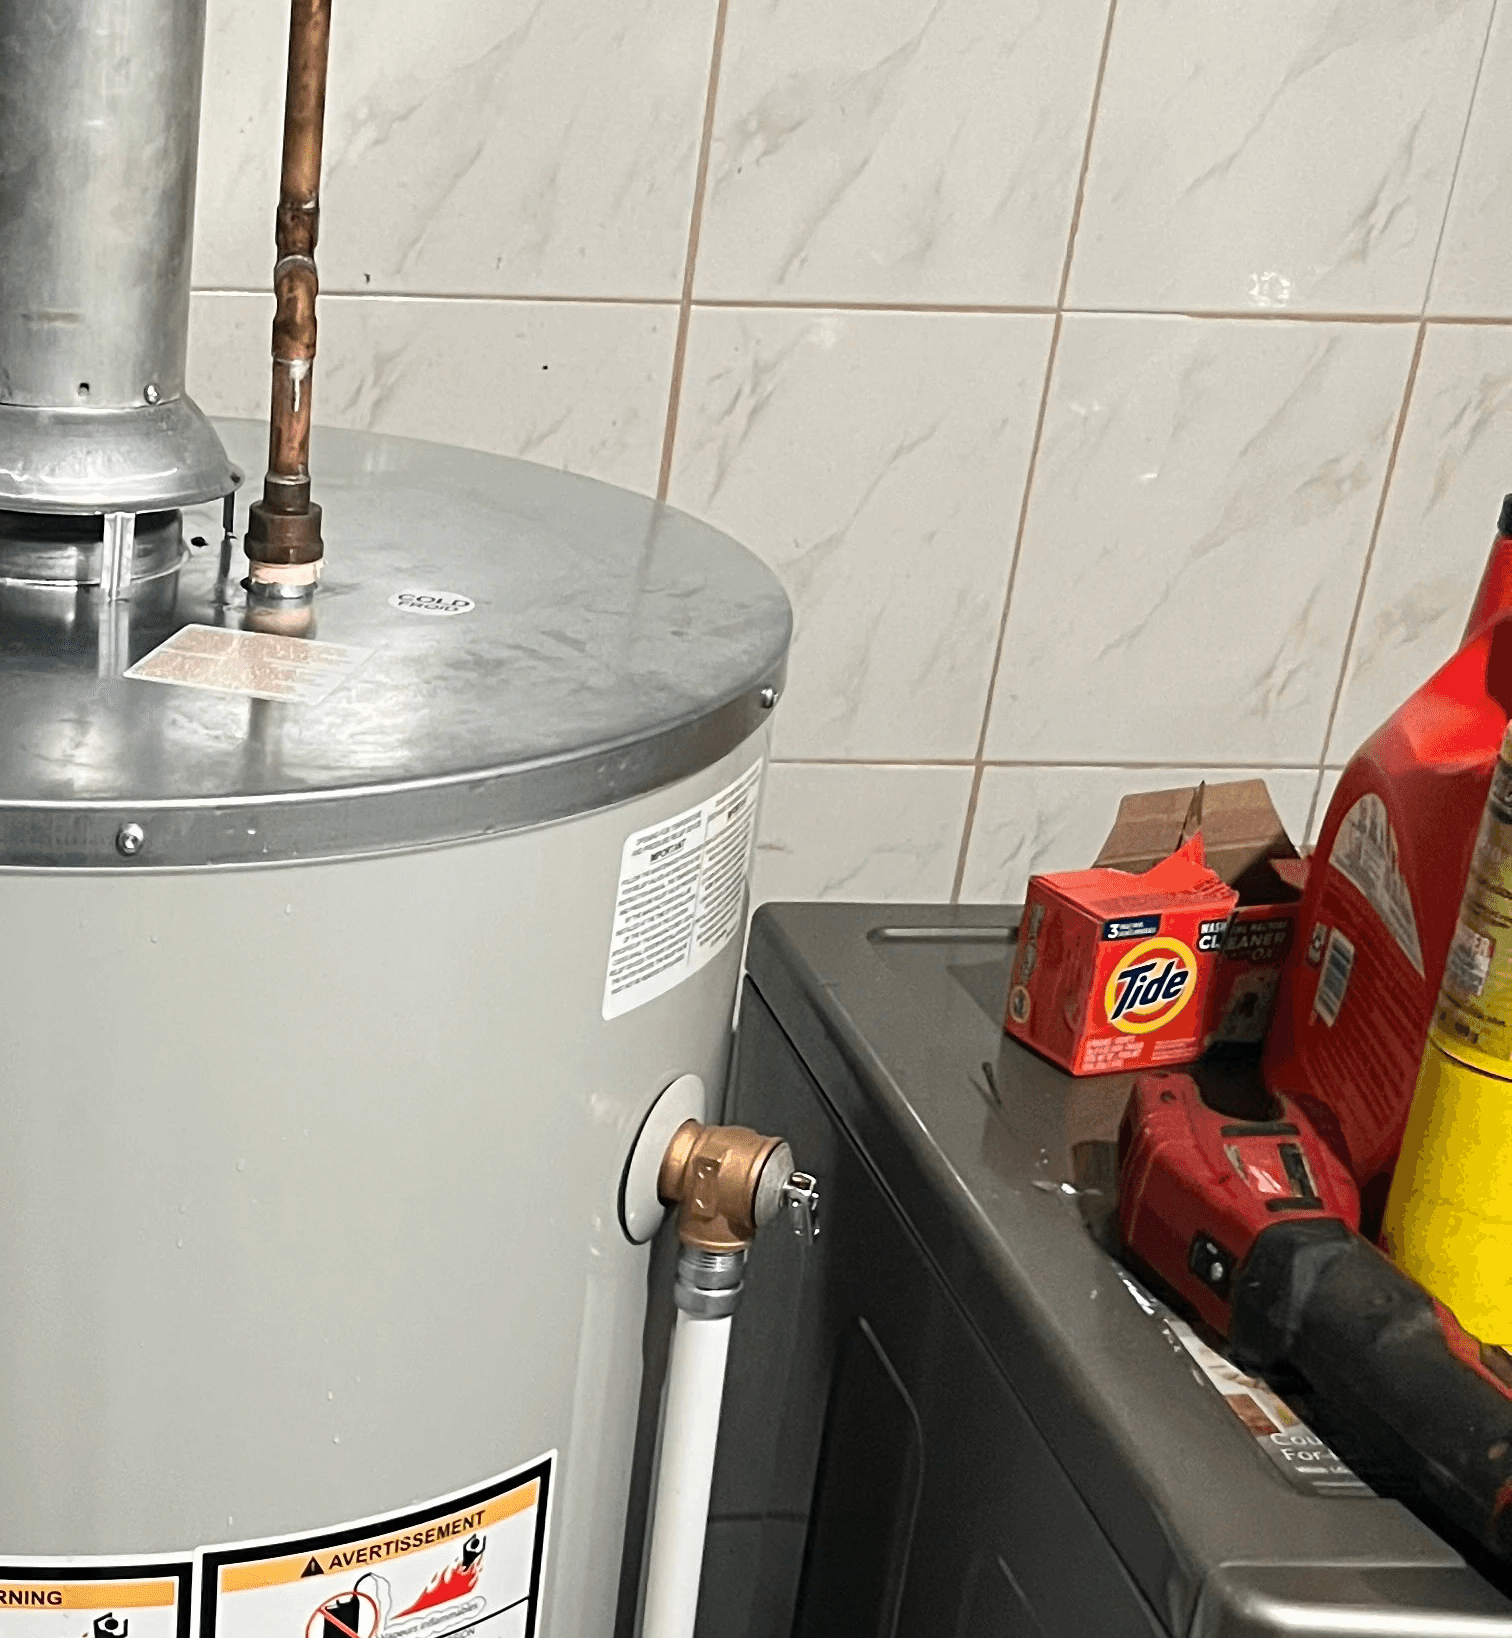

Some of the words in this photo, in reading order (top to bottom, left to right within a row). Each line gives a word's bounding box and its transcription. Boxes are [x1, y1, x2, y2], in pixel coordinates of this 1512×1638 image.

[398, 594, 470, 607] COLD
[398, 601, 459, 612] FROID
[1107, 923, 1119, 939] 3
[1111, 960, 1189, 1021] Tide
[1280, 1448, 1322, 1461] For
[328, 1509, 486, 1570] AVERTISSEMENT
